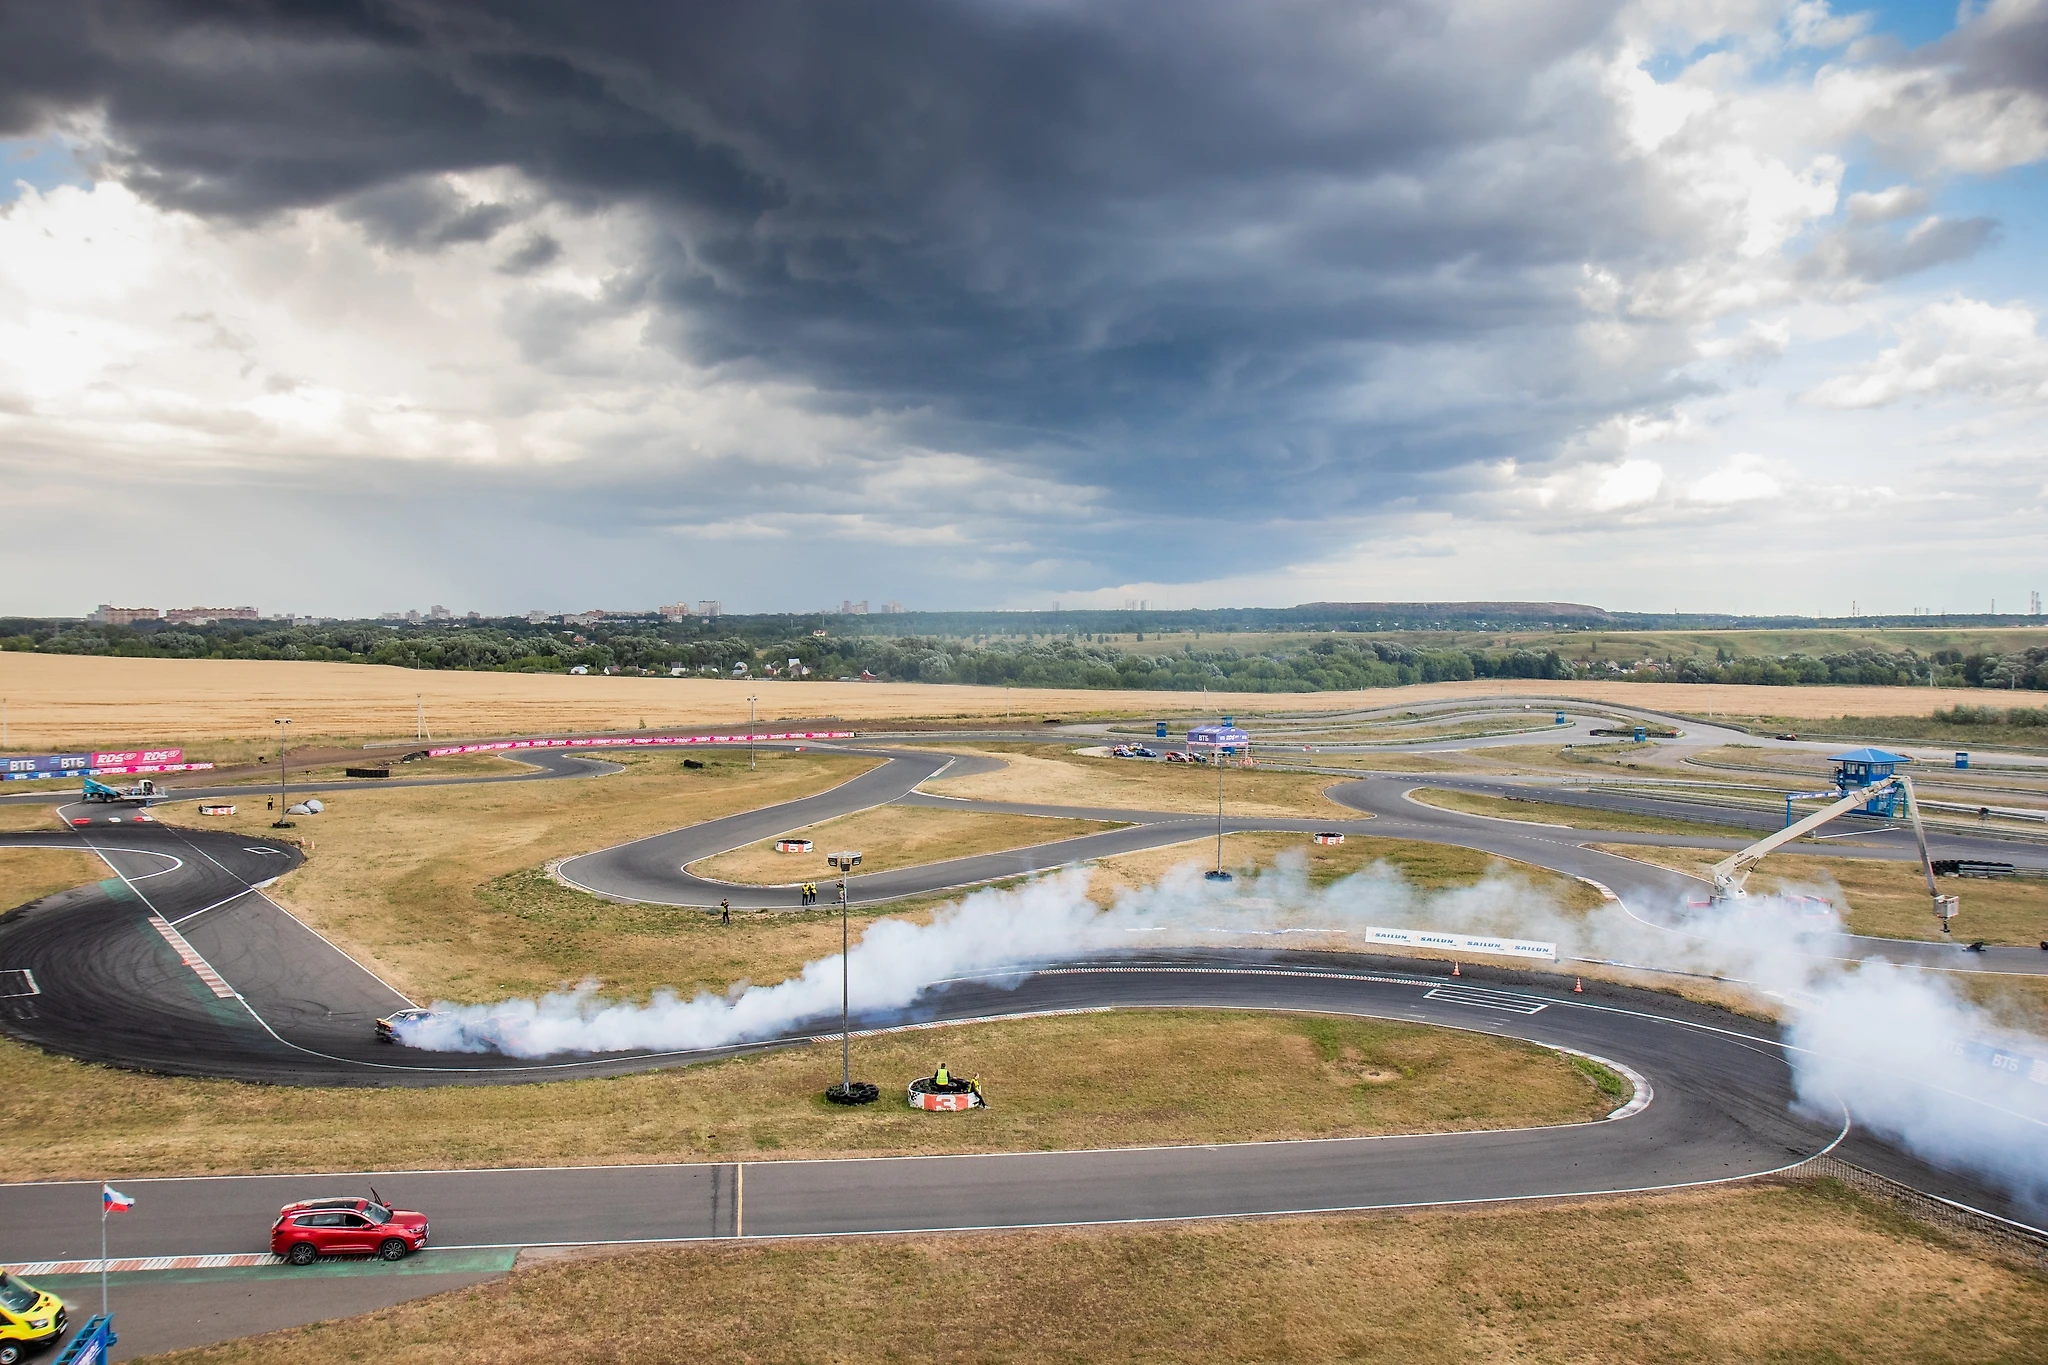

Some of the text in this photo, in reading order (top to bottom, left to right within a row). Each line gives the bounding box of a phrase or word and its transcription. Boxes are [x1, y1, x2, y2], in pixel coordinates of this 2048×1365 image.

[97, 753, 125, 764] RDS
[142, 751, 168, 761] RDS
[10, 760, 35, 771] ВТБ
[61, 757, 85, 768] ВТБ
[1375, 932, 1408, 940] SAILUN
[1420, 936, 1454, 944] SAILUN
[1514, 945, 1549, 953] SAILUN
[1992, 1053, 2020, 1072] ВТБ
[936, 1095, 957, 1112] 3
